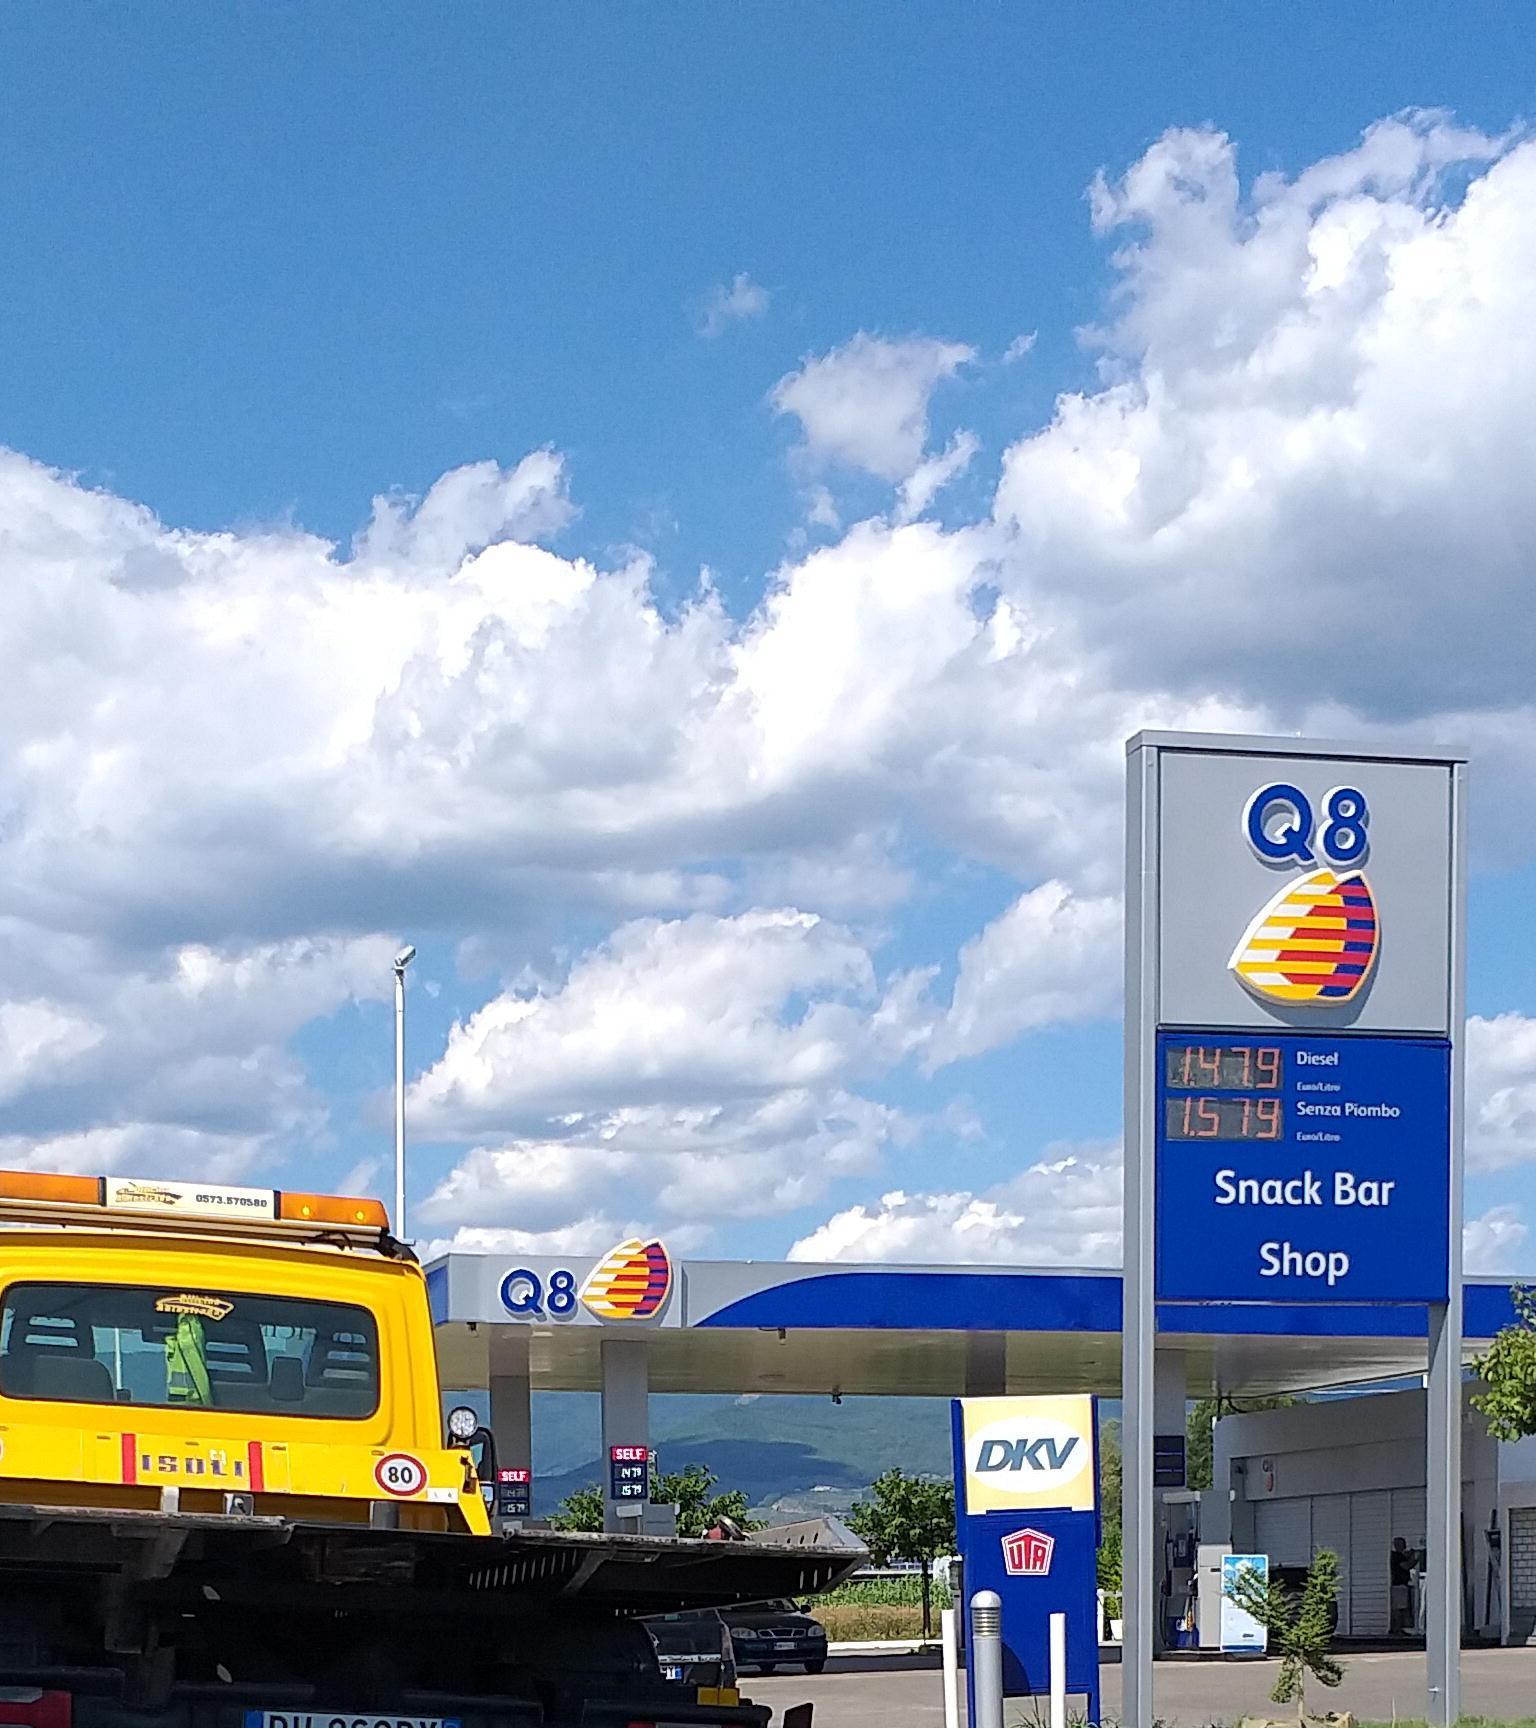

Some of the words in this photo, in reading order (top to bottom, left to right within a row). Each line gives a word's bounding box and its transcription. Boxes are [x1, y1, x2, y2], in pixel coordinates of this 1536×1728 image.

[1243, 782, 1368, 865] Q8
[1296, 1051, 1339, 1066] Diesel
[1296, 1101, 1341, 1116] Senza
[1345, 1102, 1400, 1117] Piombo
[1215, 1169, 1323, 1205] Snack
[1334, 1171, 1395, 1205] Bar
[1259, 1241, 1350, 1286] Shop
[498, 1268, 577, 1315] Q8
[615, 1448, 644, 1460] SELF
[975, 1437, 1080, 1472] DKV
[388, 1466, 413, 1484] 80
[501, 1471, 527, 1482] SELF
[1007, 1534, 1049, 1570] UTA
